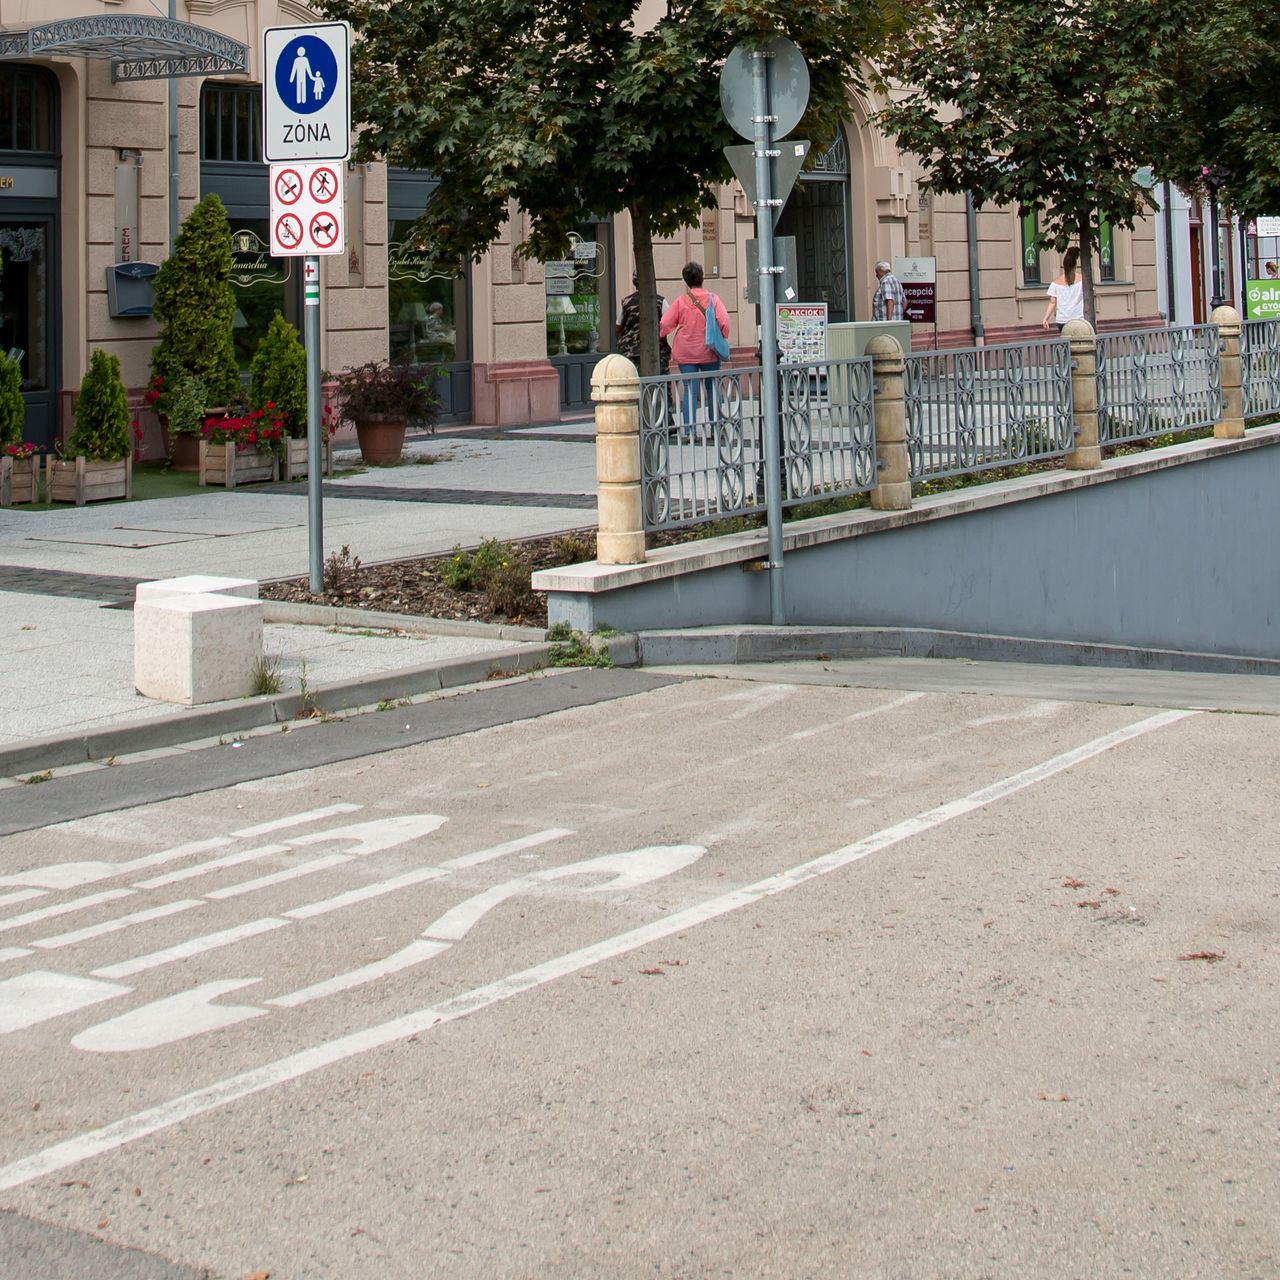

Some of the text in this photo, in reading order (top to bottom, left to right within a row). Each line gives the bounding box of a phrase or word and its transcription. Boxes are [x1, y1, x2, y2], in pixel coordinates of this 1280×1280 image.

[283, 119, 331, 143] ZÓNA
[122, 227, 130, 262] EREM
[903, 287, 934, 298] ecepció
